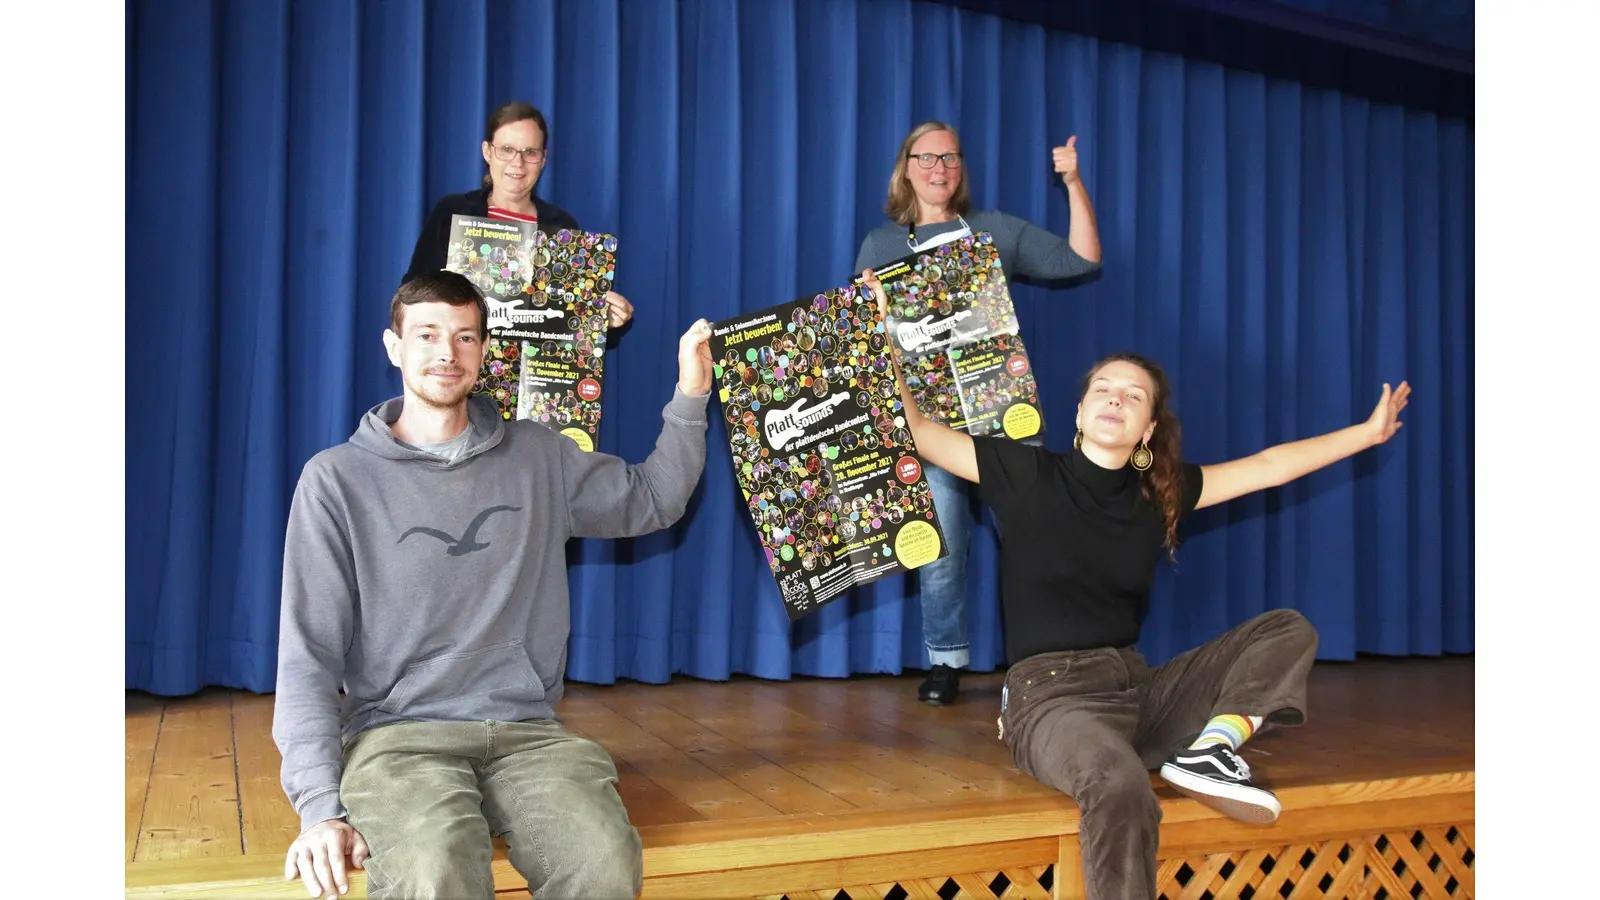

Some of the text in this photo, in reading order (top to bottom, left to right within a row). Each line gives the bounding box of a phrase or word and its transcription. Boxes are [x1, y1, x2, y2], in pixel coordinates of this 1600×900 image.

[464, 227, 522, 241] Jetzt bewerben!
[487, 306, 507, 319] latt
[507, 313, 545, 323] sounds
[501, 329, 540, 339] plattdeutsche
[540, 331, 574, 341] Bandcontest
[724, 319, 783, 347] Jetzt bewerben!
[536, 368, 565, 377] November
[565, 371, 579, 380] 2021
[795, 405, 834, 430] sounds
[767, 413, 796, 438] Platt
[784, 412, 870, 452] der plattdeutsche Bandcontest
[832, 451, 879, 471] Großes Finale am
[835, 455, 893, 481] 20. November 2021
[785, 569, 802, 581] PLATT
[790, 582, 808, 594] COOL
